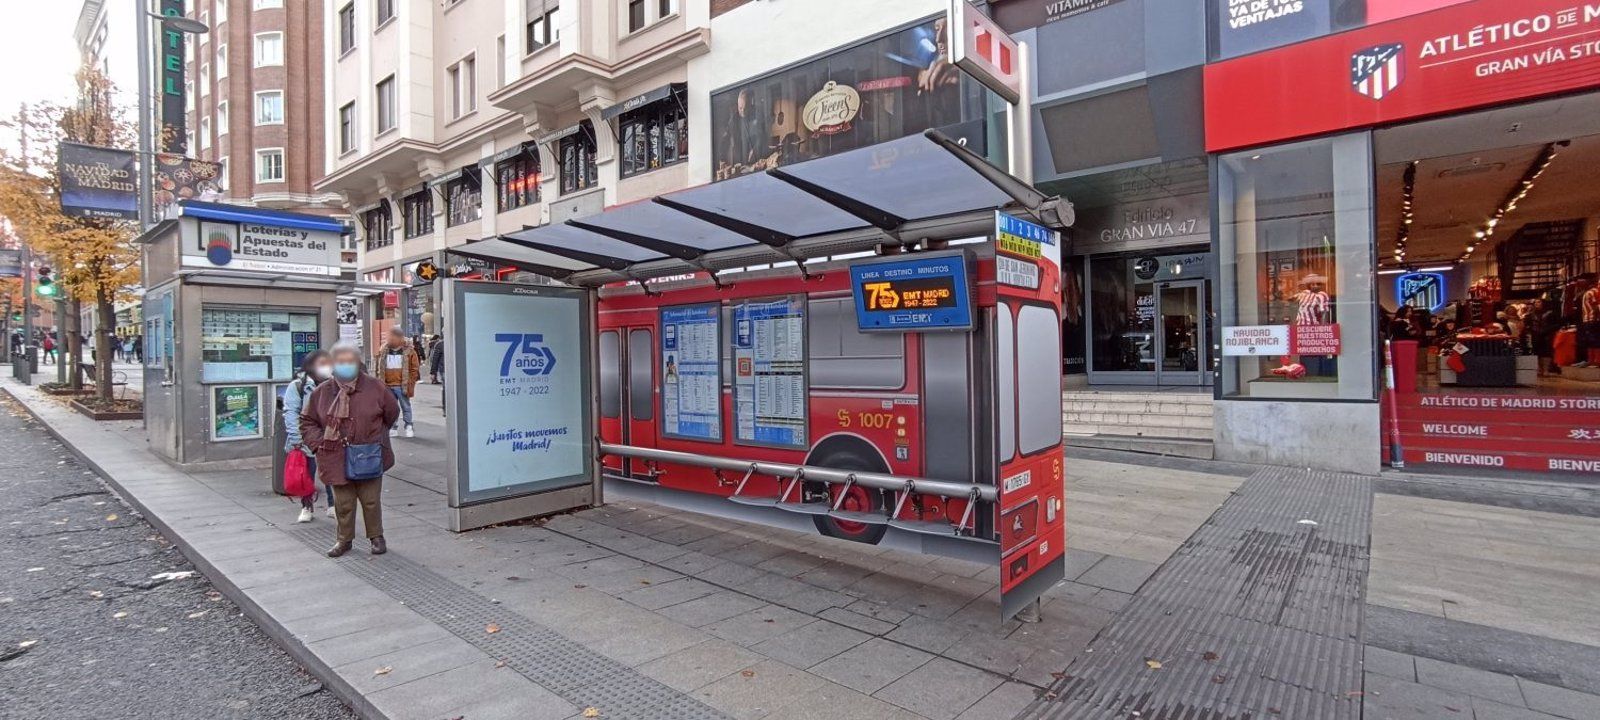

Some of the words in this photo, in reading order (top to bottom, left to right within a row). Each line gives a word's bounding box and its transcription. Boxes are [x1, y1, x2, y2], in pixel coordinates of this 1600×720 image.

[1229, 4, 1249, 18] YA
[1250, 0, 1269, 13] DE
[1229, 0, 1304, 29] VENTAJAS
[1419, 14, 1551, 59] ATLÉTICO
[1556, 12, 1577, 25] DE
[164, 0, 181, 95] OTEL
[1475, 55, 1529, 77] GRAN
[1532, 47, 1566, 66] VÍA
[65, 163, 129, 178] NAVIDAD
[78, 178, 135, 192] MADRID
[1124, 207, 1174, 223] Edificio
[243, 224, 297, 237] Loterías
[300, 230, 309, 240] y
[1018, 222, 1023, 235] 2
[1027, 225, 1031, 238] 3
[1101, 225, 1144, 242] GRAN
[1147, 222, 1174, 237] VIA
[1178, 218, 1197, 234] 47
[243, 235, 304, 249] Apuestas
[307, 241, 327, 251] del
[243, 246, 289, 258] Estado
[884, 269, 913, 277] DESTINO
[917, 265, 949, 274] MINUTOS
[903, 291, 921, 300] EMT
[923, 288, 950, 299] MADRID
[1233, 328, 1271, 337] NAVIDAD
[1226, 337, 1279, 346] ROJIBLANCA
[1296, 338, 1340, 346] PRODUCTOS
[495, 333, 544, 377] 75
[515, 356, 545, 368] años
[500, 387, 521, 396] 1947
[529, 385, 549, 395] 2022
[1421, 395, 1478, 407] ATLÉTICO
[1481, 398, 1498, 407] DE
[1501, 398, 1556, 409] MADRID
[858, 412, 894, 429] 1007
[525, 426, 567, 438] movemos
[1422, 423, 1488, 436] WELCOME
[512, 438, 551, 452] Madrid!
[1425, 452, 1504, 467] BIENVENIDO
